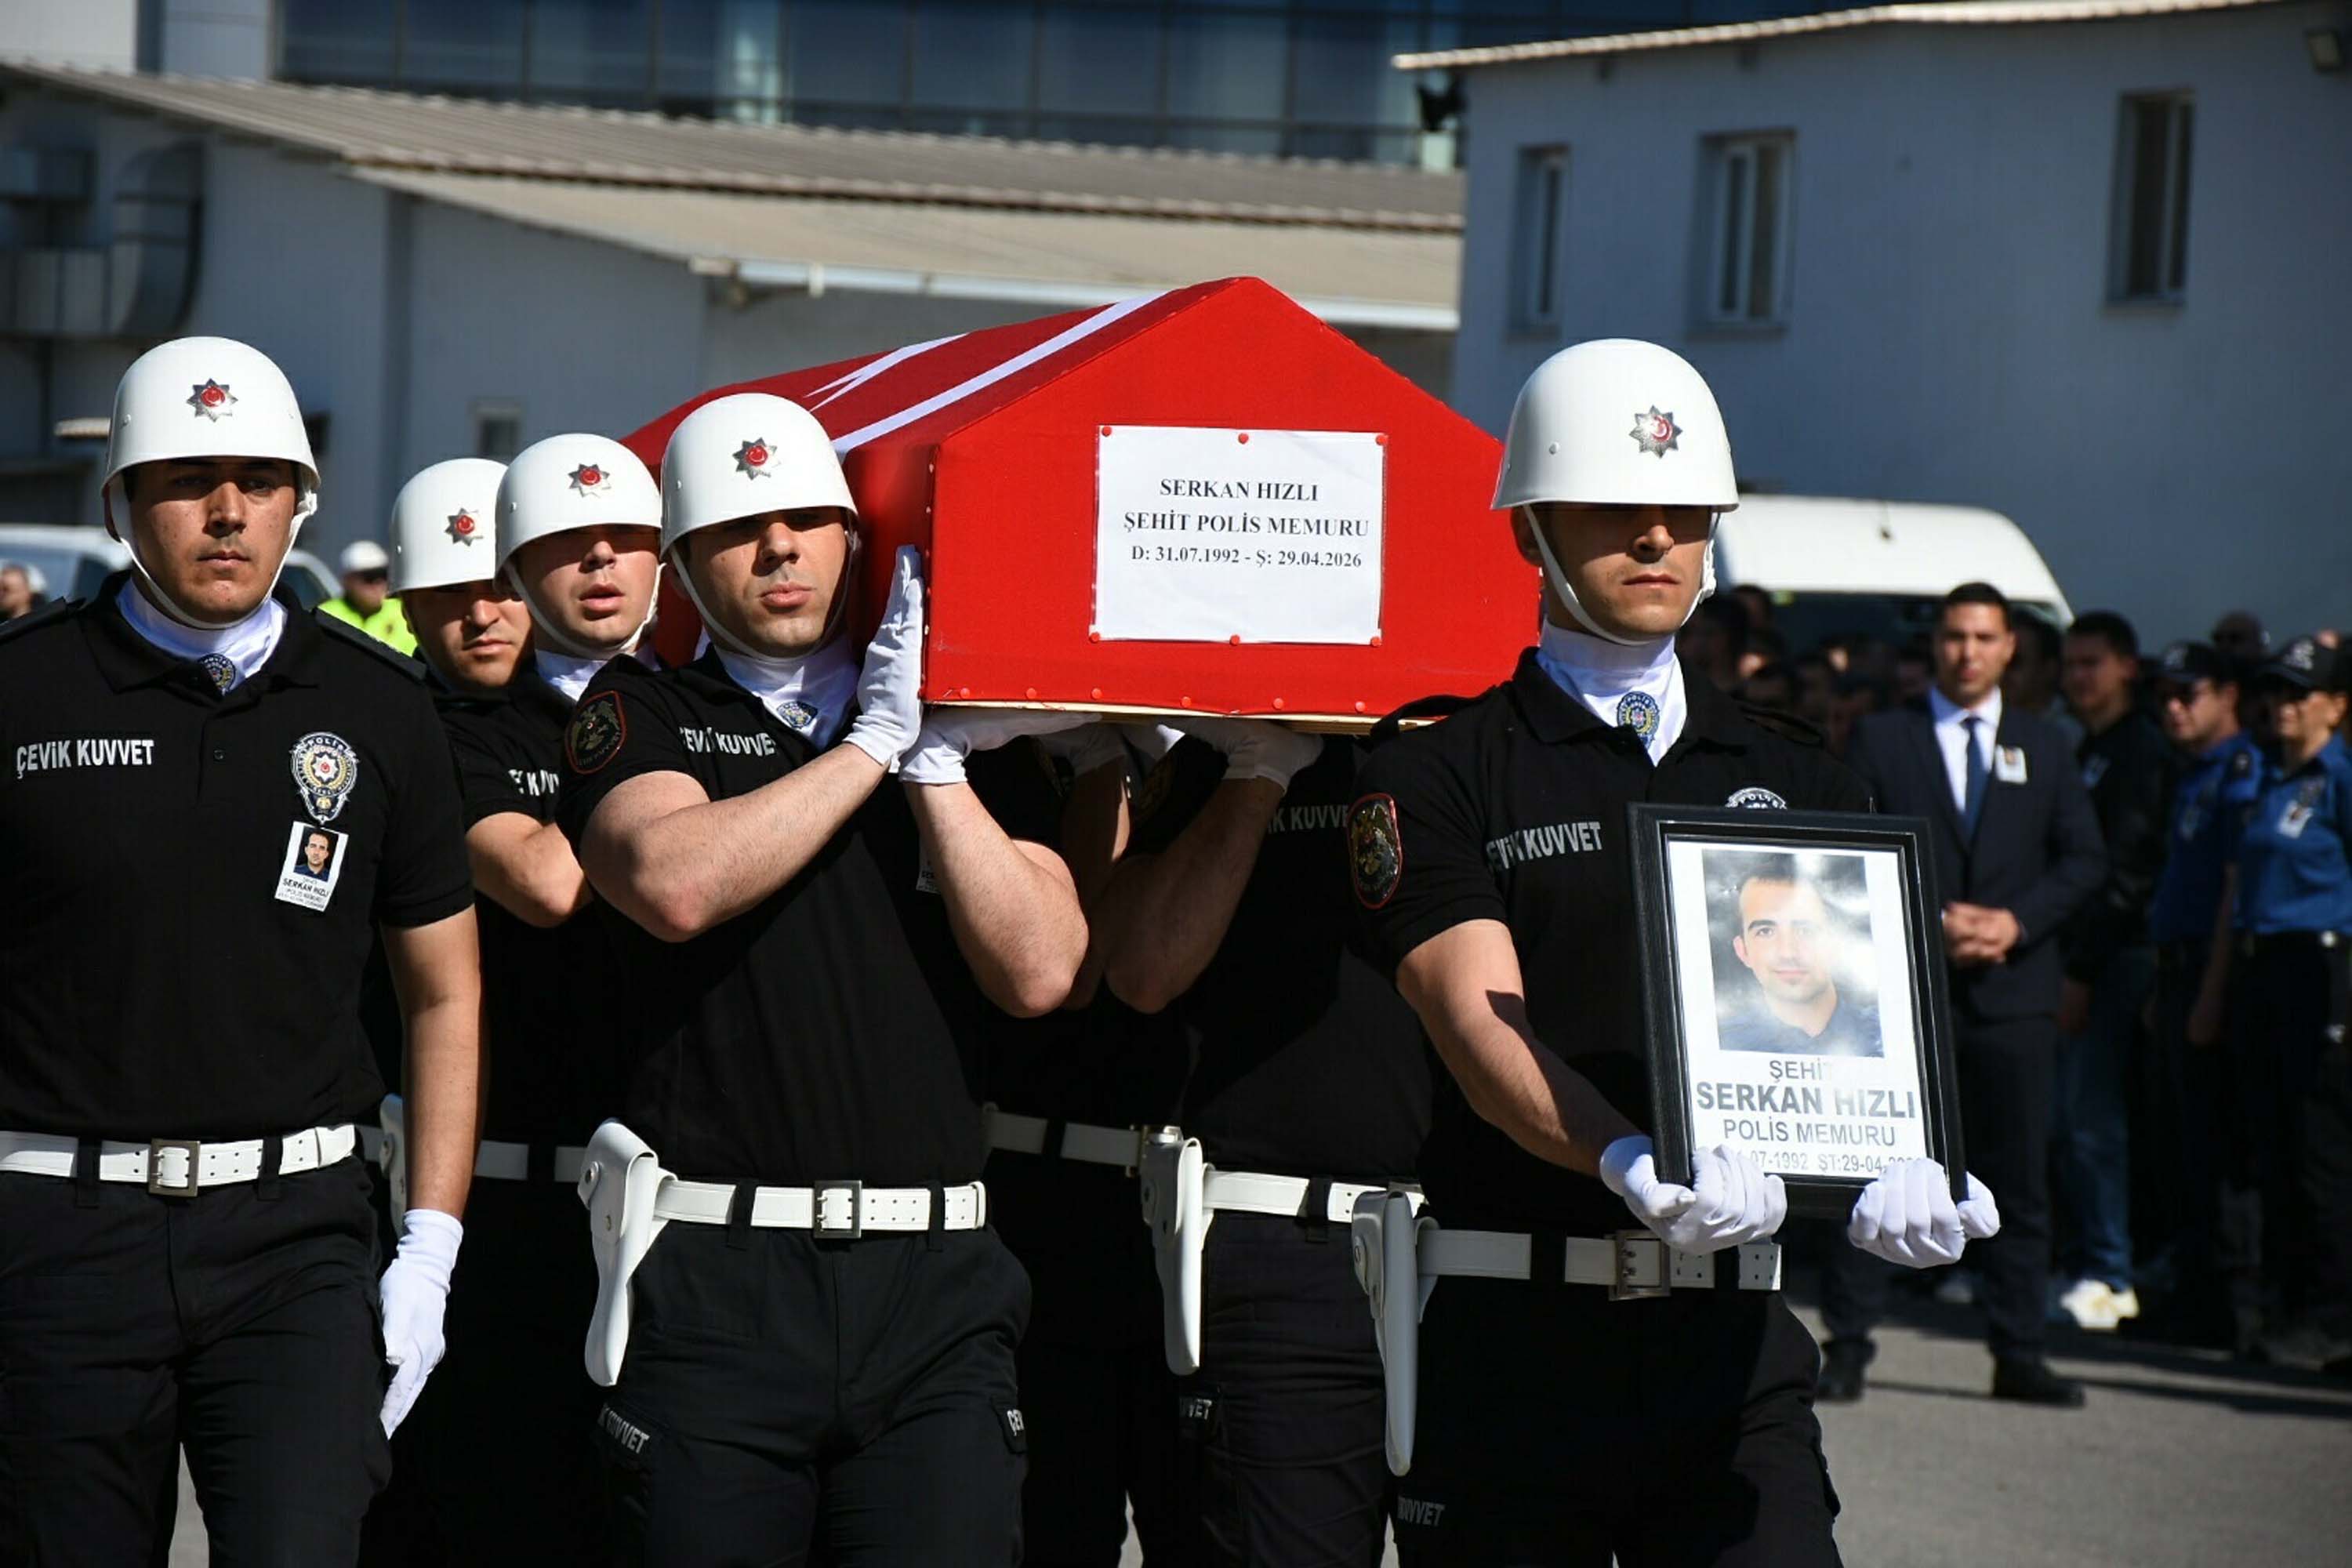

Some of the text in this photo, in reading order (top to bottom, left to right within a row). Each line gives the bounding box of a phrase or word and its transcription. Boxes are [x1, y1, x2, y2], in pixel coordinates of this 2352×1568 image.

[1160, 479, 1319, 502] SERKAN HIZLI
[1123, 510, 1370, 537] ŞEHİT POLİS MEMURU
[1131, 546, 1150, 561] D:
[1155, 546, 1240, 564] 31.07.1992
[1256, 550, 1272, 569] Ş:
[1277, 550, 1363, 568] 29.04.2026
[77, 739, 155, 766] KUVVET
[714, 731, 776, 757] KUVVE
[1523, 821, 1602, 860] KUVVET
[1769, 1058, 1830, 1083] ŞEHİ
[1696, 1081, 1916, 1119] SERKAN HIZLI
[1723, 1116, 1896, 1146] POLİS MEMURU
